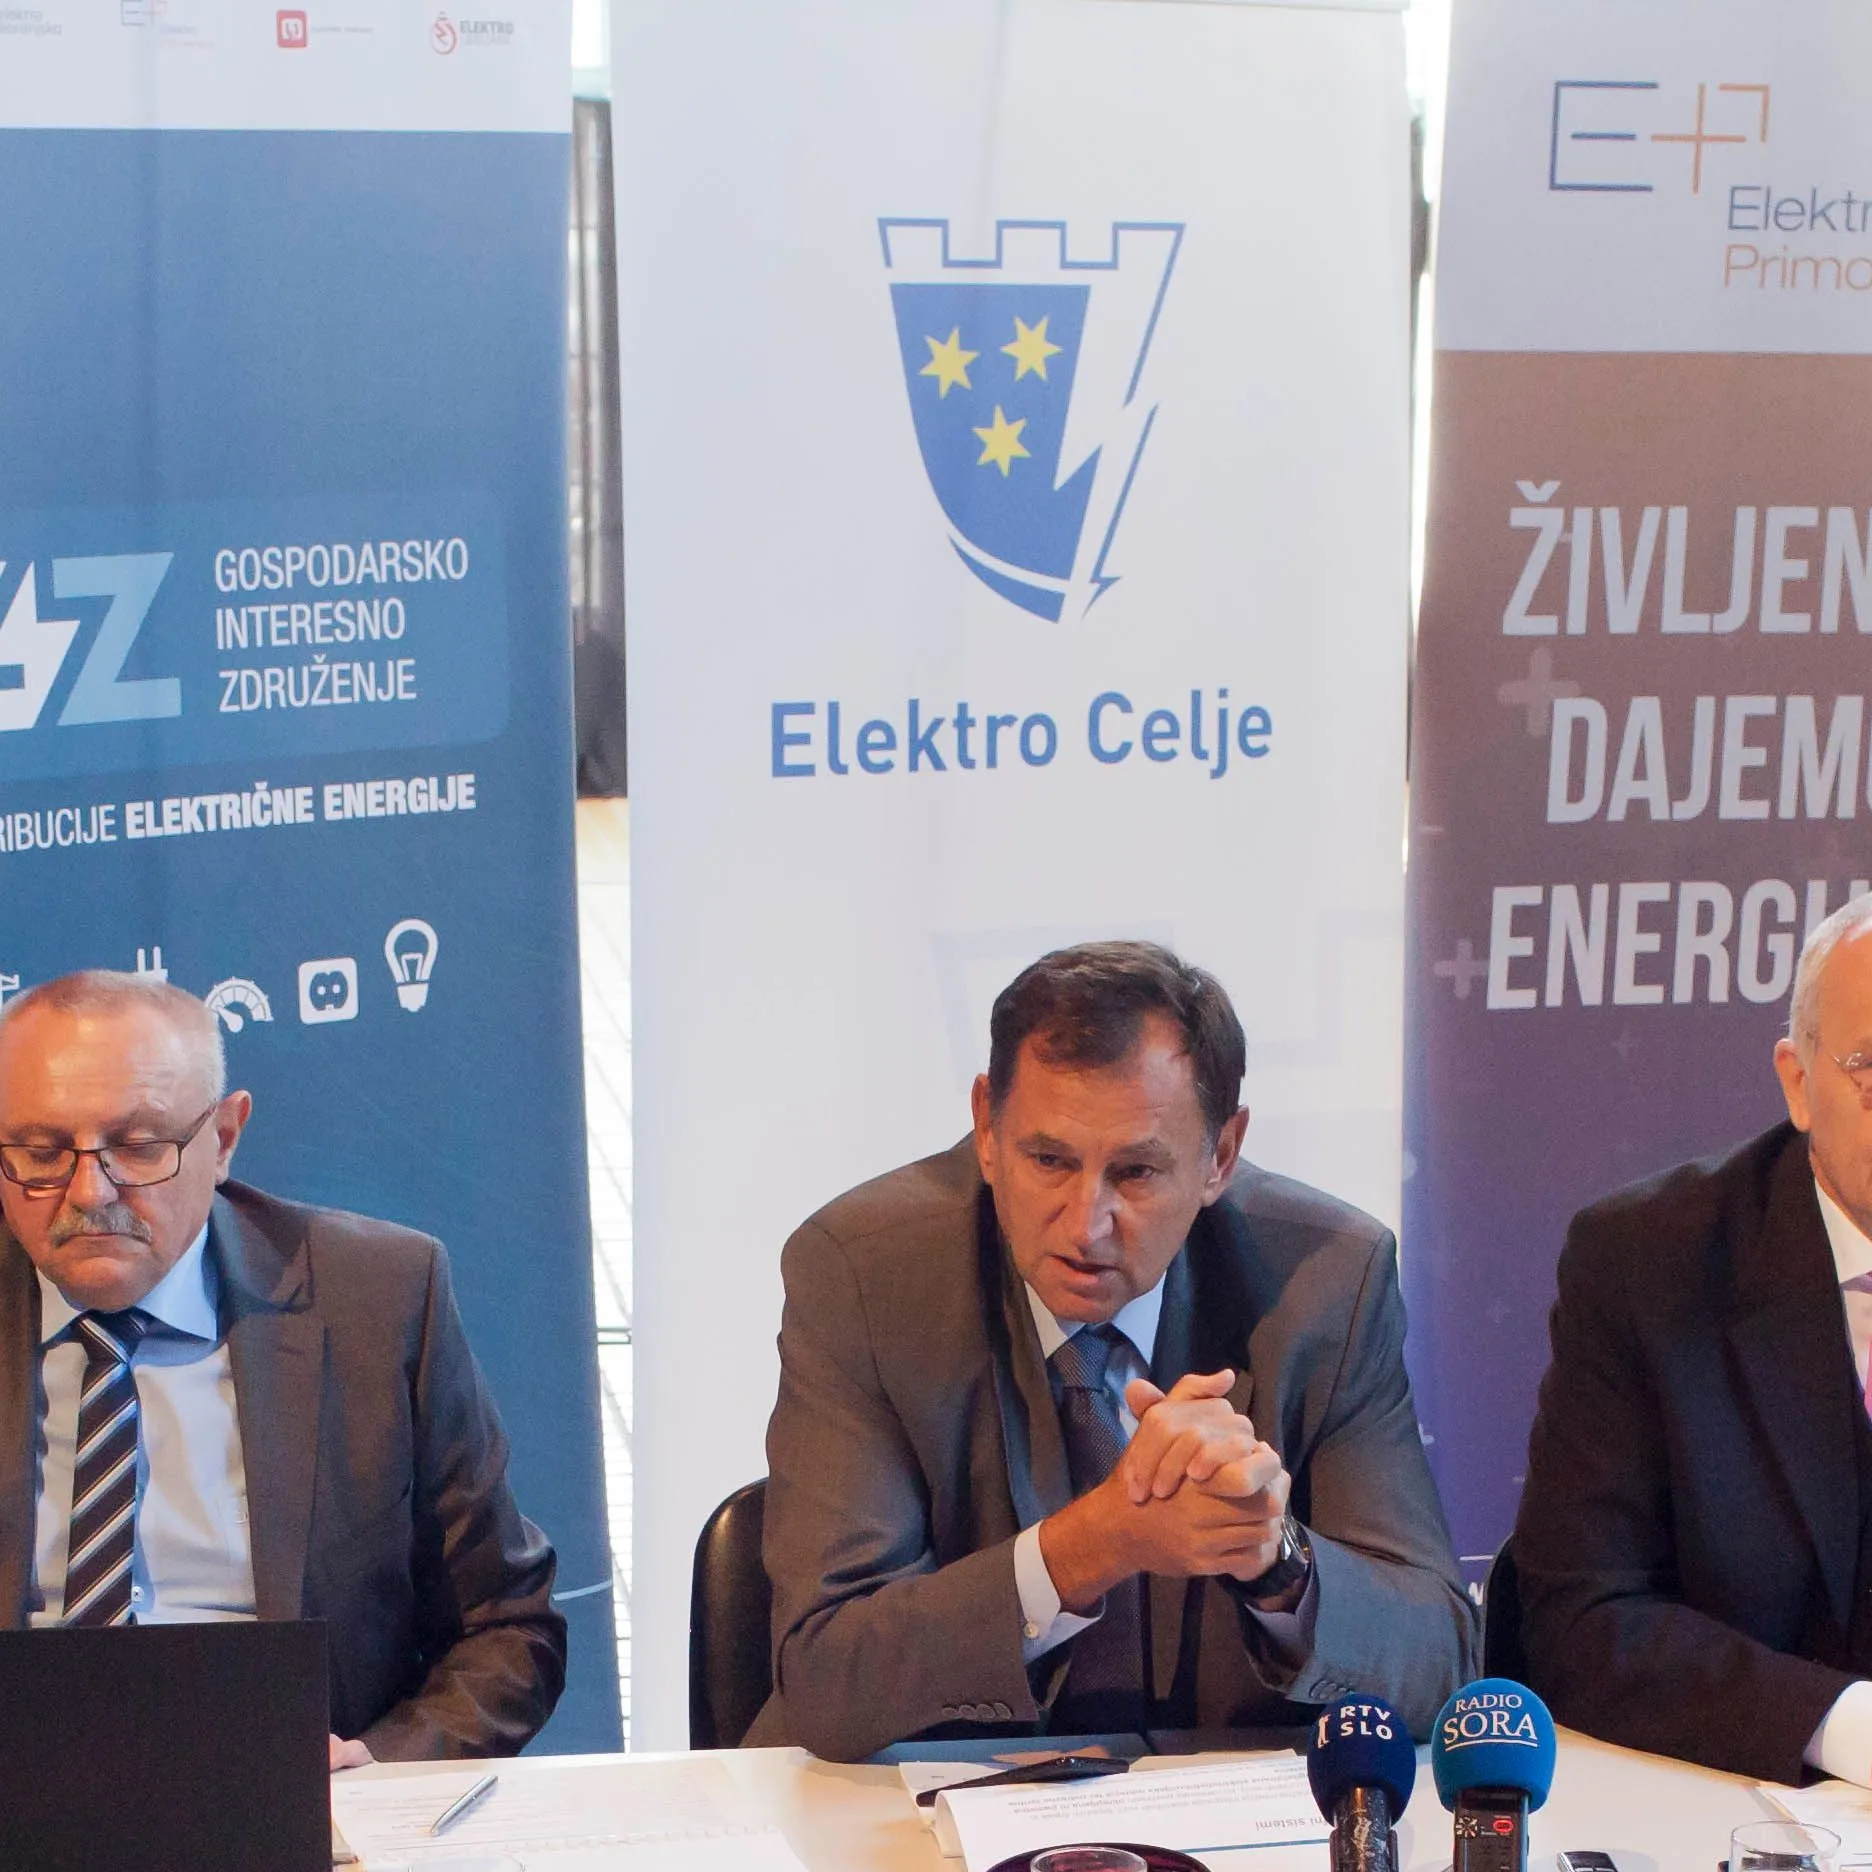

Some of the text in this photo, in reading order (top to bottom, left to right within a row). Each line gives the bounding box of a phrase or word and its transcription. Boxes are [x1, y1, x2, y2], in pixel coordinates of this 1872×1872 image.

[214, 538, 470, 594] GOSPODARSKO
[214, 598, 407, 652] INTERESNO
[218, 654, 417, 715] ZDRUŽENJE
[771, 687, 1273, 780] Elektro Celje
[126, 778, 315, 841] ELEKTRIČNE
[323, 772, 476, 824] ENERGIJE
[1340, 1705, 1392, 1720] RTV
[1443, 1711, 1539, 1745] SORA
[1455, 1694, 1522, 1713] RADIO
[1340, 1722, 1393, 1740] SLO
